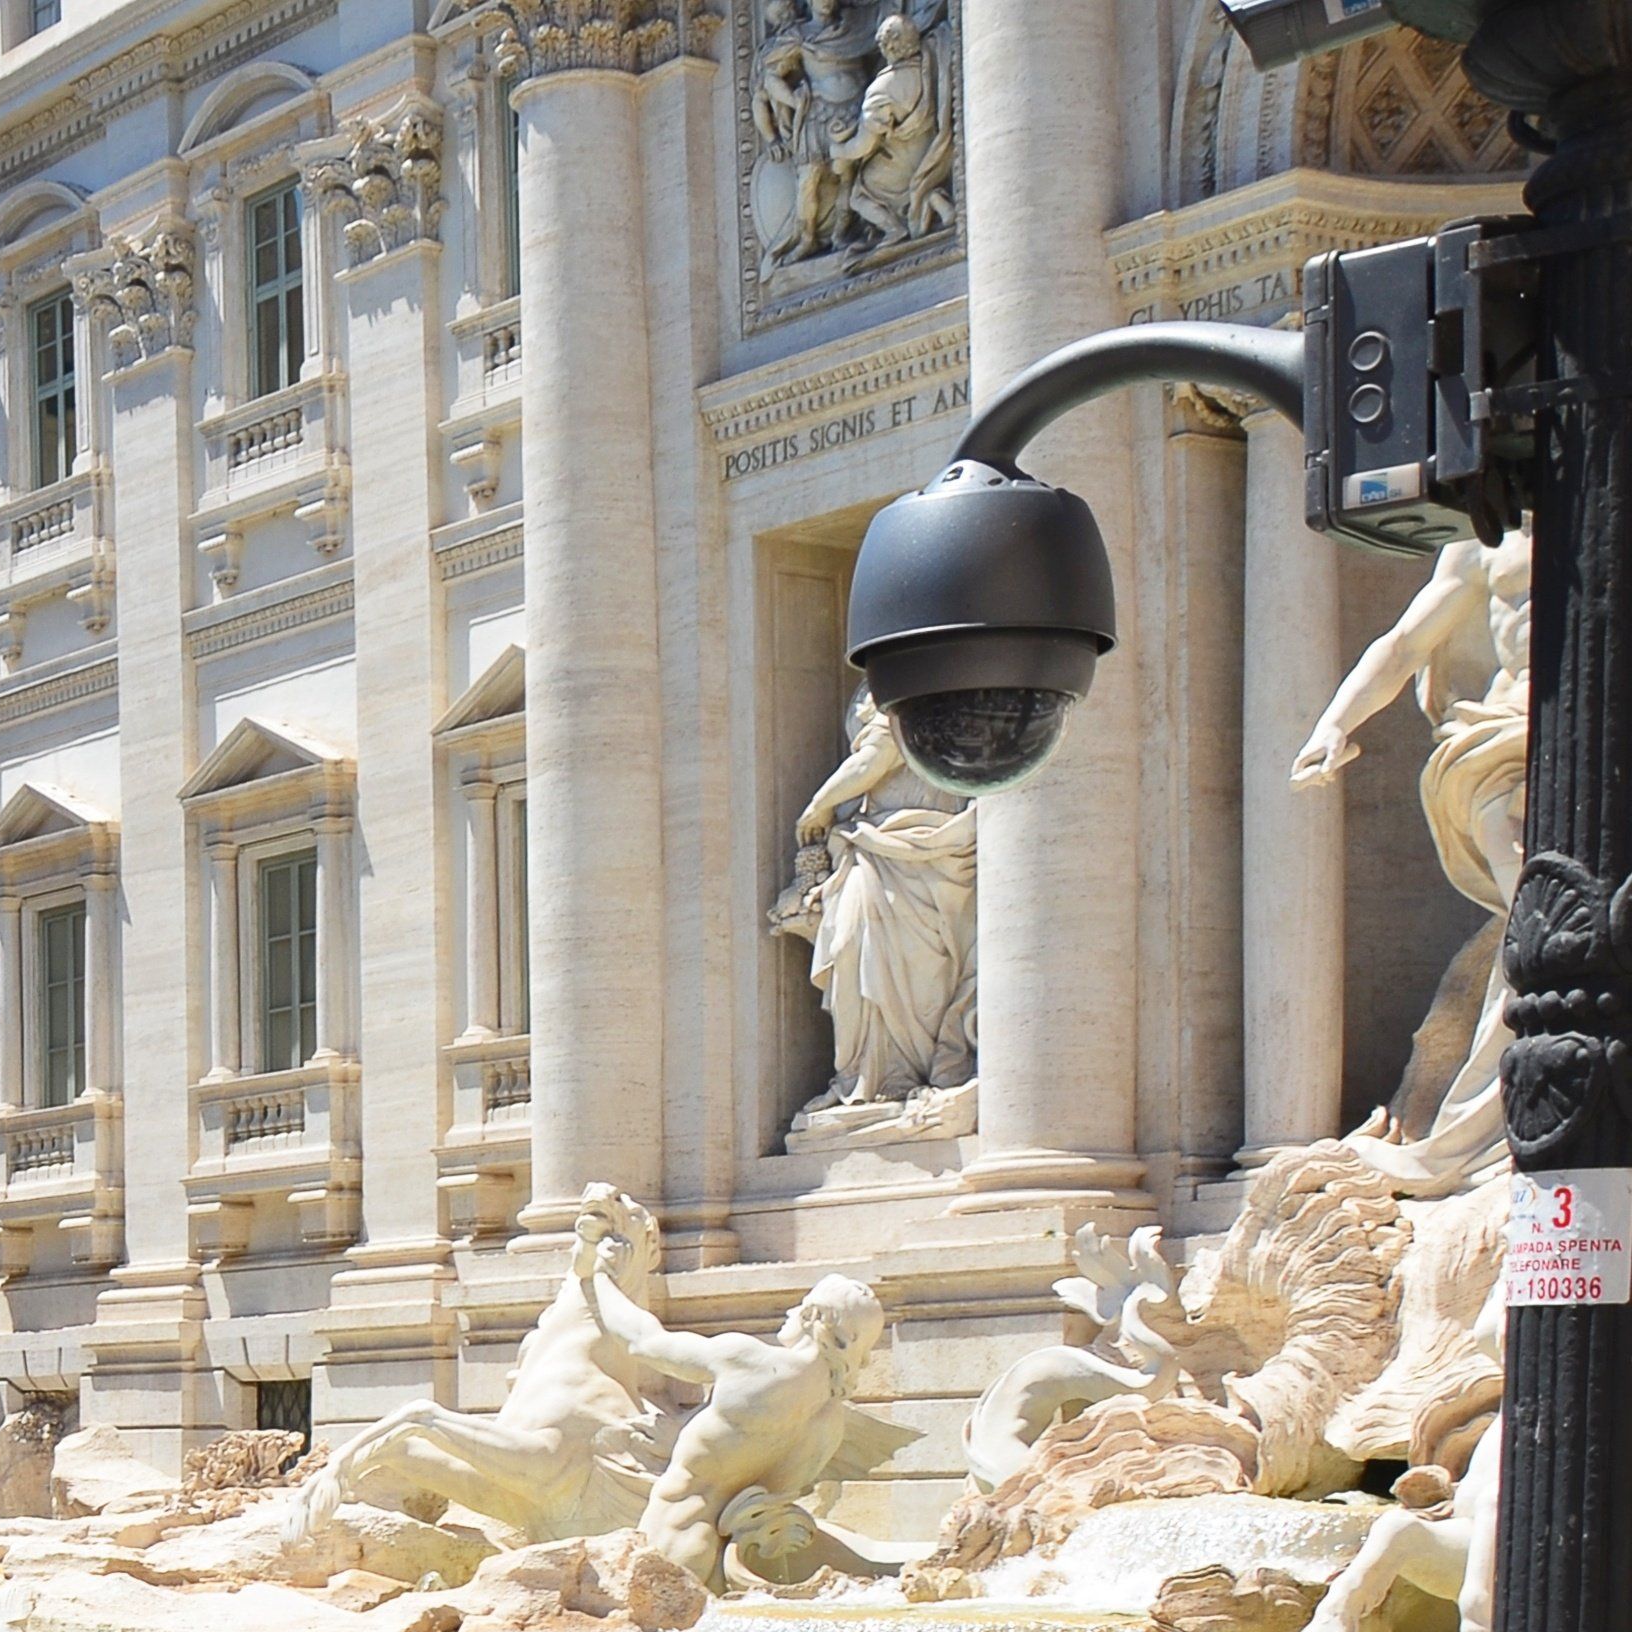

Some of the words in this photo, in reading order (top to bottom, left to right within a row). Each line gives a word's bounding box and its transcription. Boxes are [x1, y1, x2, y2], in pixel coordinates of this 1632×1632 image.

[724, 434, 799, 479] POSITIS
[809, 409, 876, 452] SIGNIS
[891, 395, 917, 427] ET
[1531, 1223, 1544, 1233] N.
[1552, 1186, 1572, 1228] 3
[1511, 1241, 1553, 1254] AMPADA
[1558, 1239, 1622, 1253] SPENTA
